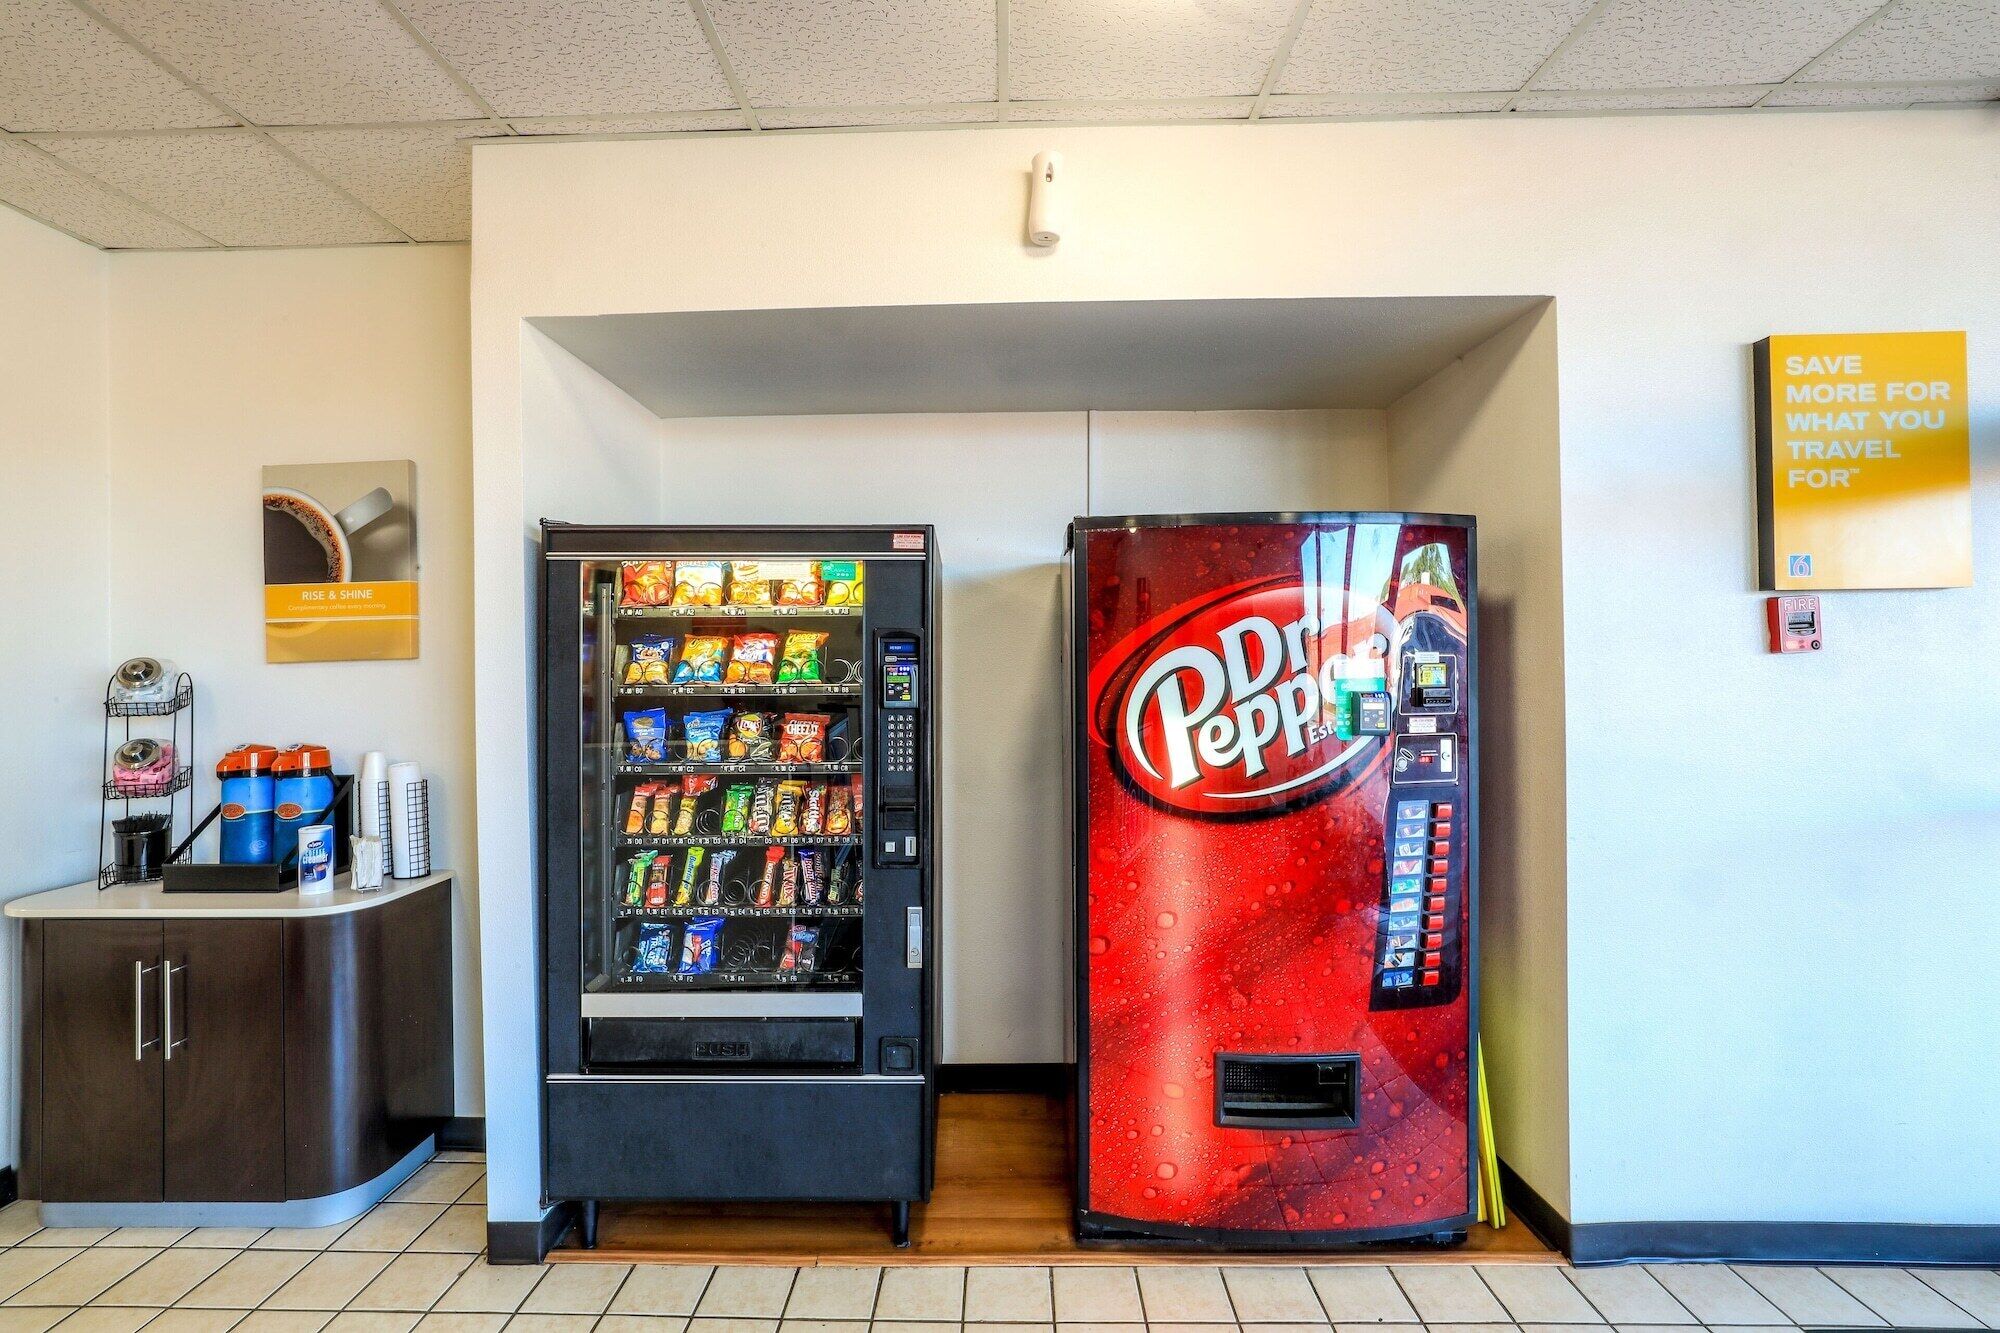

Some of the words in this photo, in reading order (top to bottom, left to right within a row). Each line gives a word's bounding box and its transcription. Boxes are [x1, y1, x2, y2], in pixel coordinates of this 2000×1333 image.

[1785, 355, 1862, 376] SAVE
[1786, 383, 1877, 403] MORE
[1886, 381, 1951, 401] FOR
[1785, 411, 1870, 431] WHAT
[1879, 410, 1945, 430] YOU
[1787, 440, 1901, 460] TRAVEL
[302, 591, 325, 600] RISE
[328, 590, 337, 600] &
[340, 589, 373, 600] SHINE
[1784, 599, 1816, 610] FIRE
[1217, 613, 1321, 703] Dr
[1125, 633, 1389, 788] Pepp
[697, 1043, 748, 1056] PUSH
